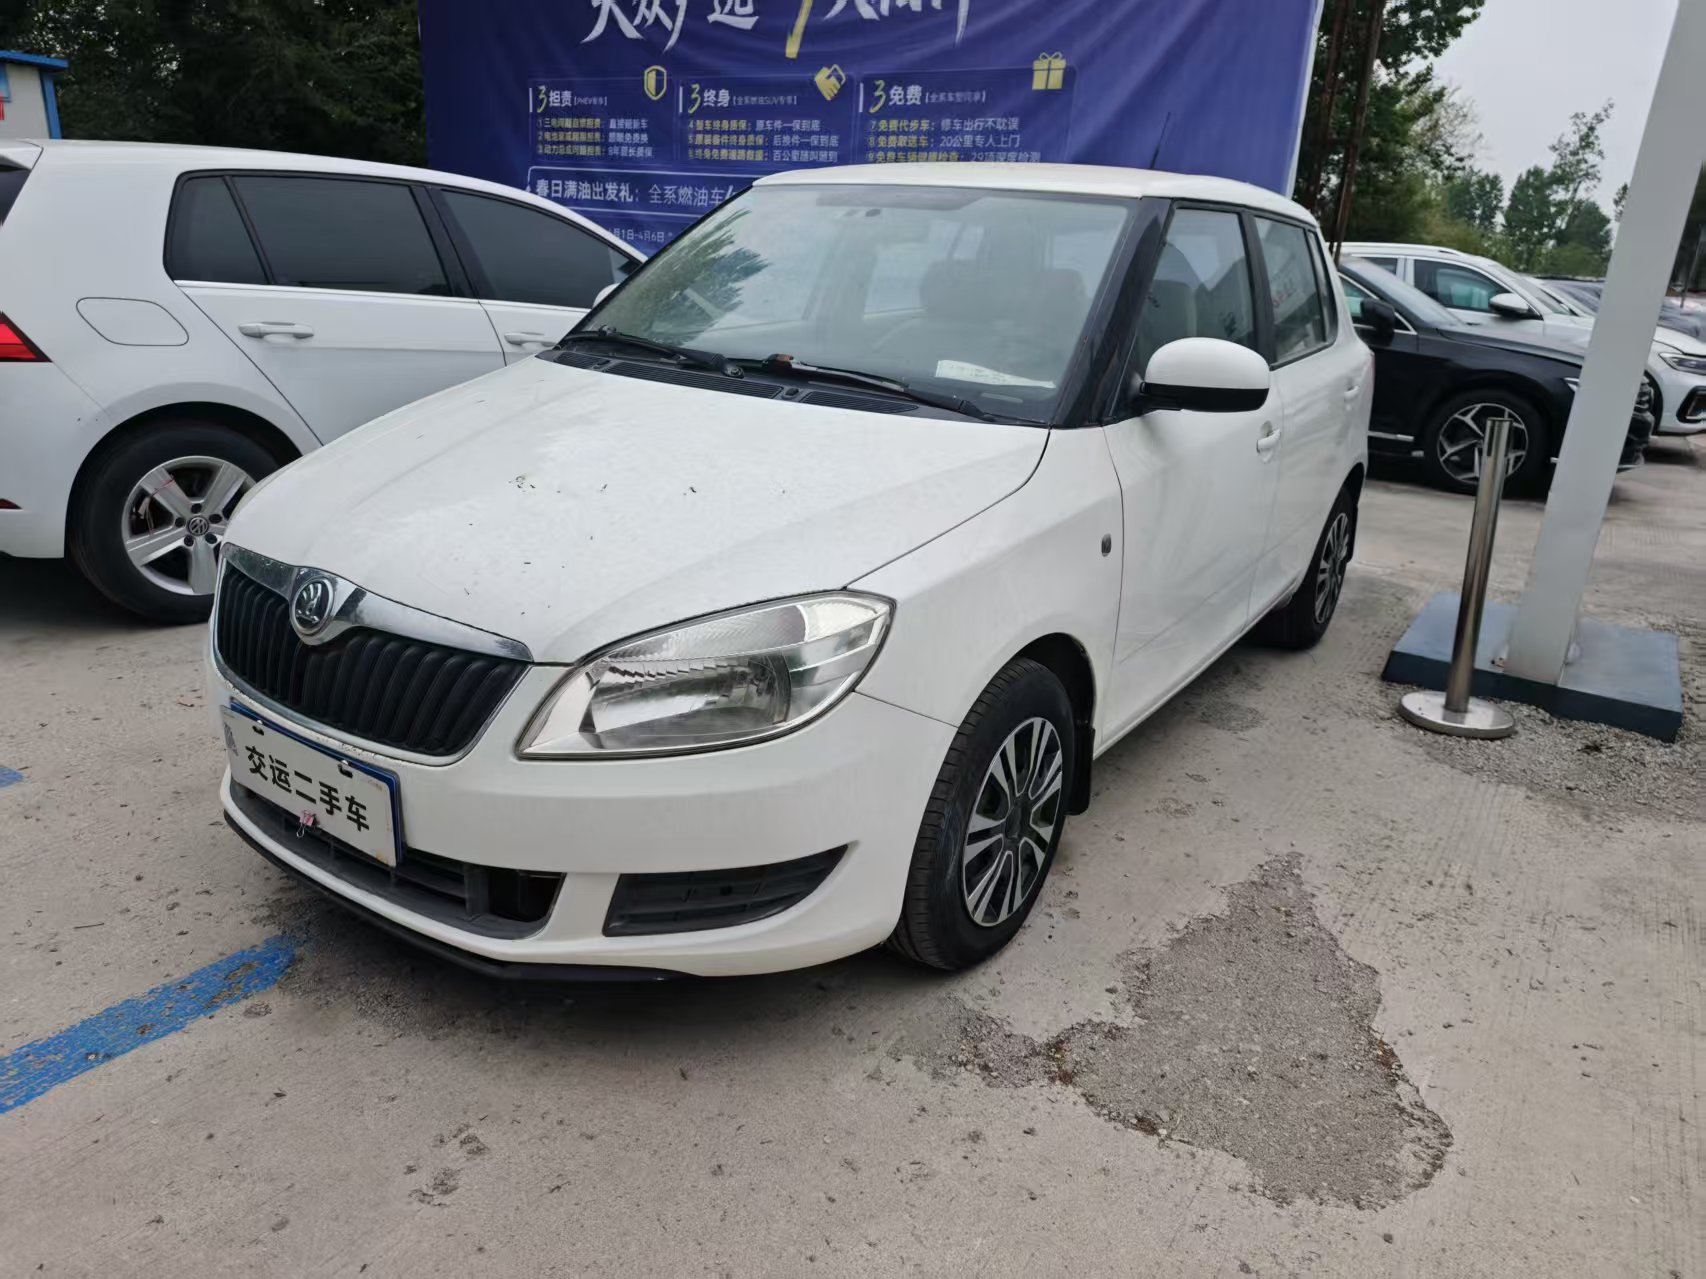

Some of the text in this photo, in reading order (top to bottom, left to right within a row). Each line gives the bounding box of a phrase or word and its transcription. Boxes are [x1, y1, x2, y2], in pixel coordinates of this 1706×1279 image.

[245, 745, 370, 832] 交运二手车
